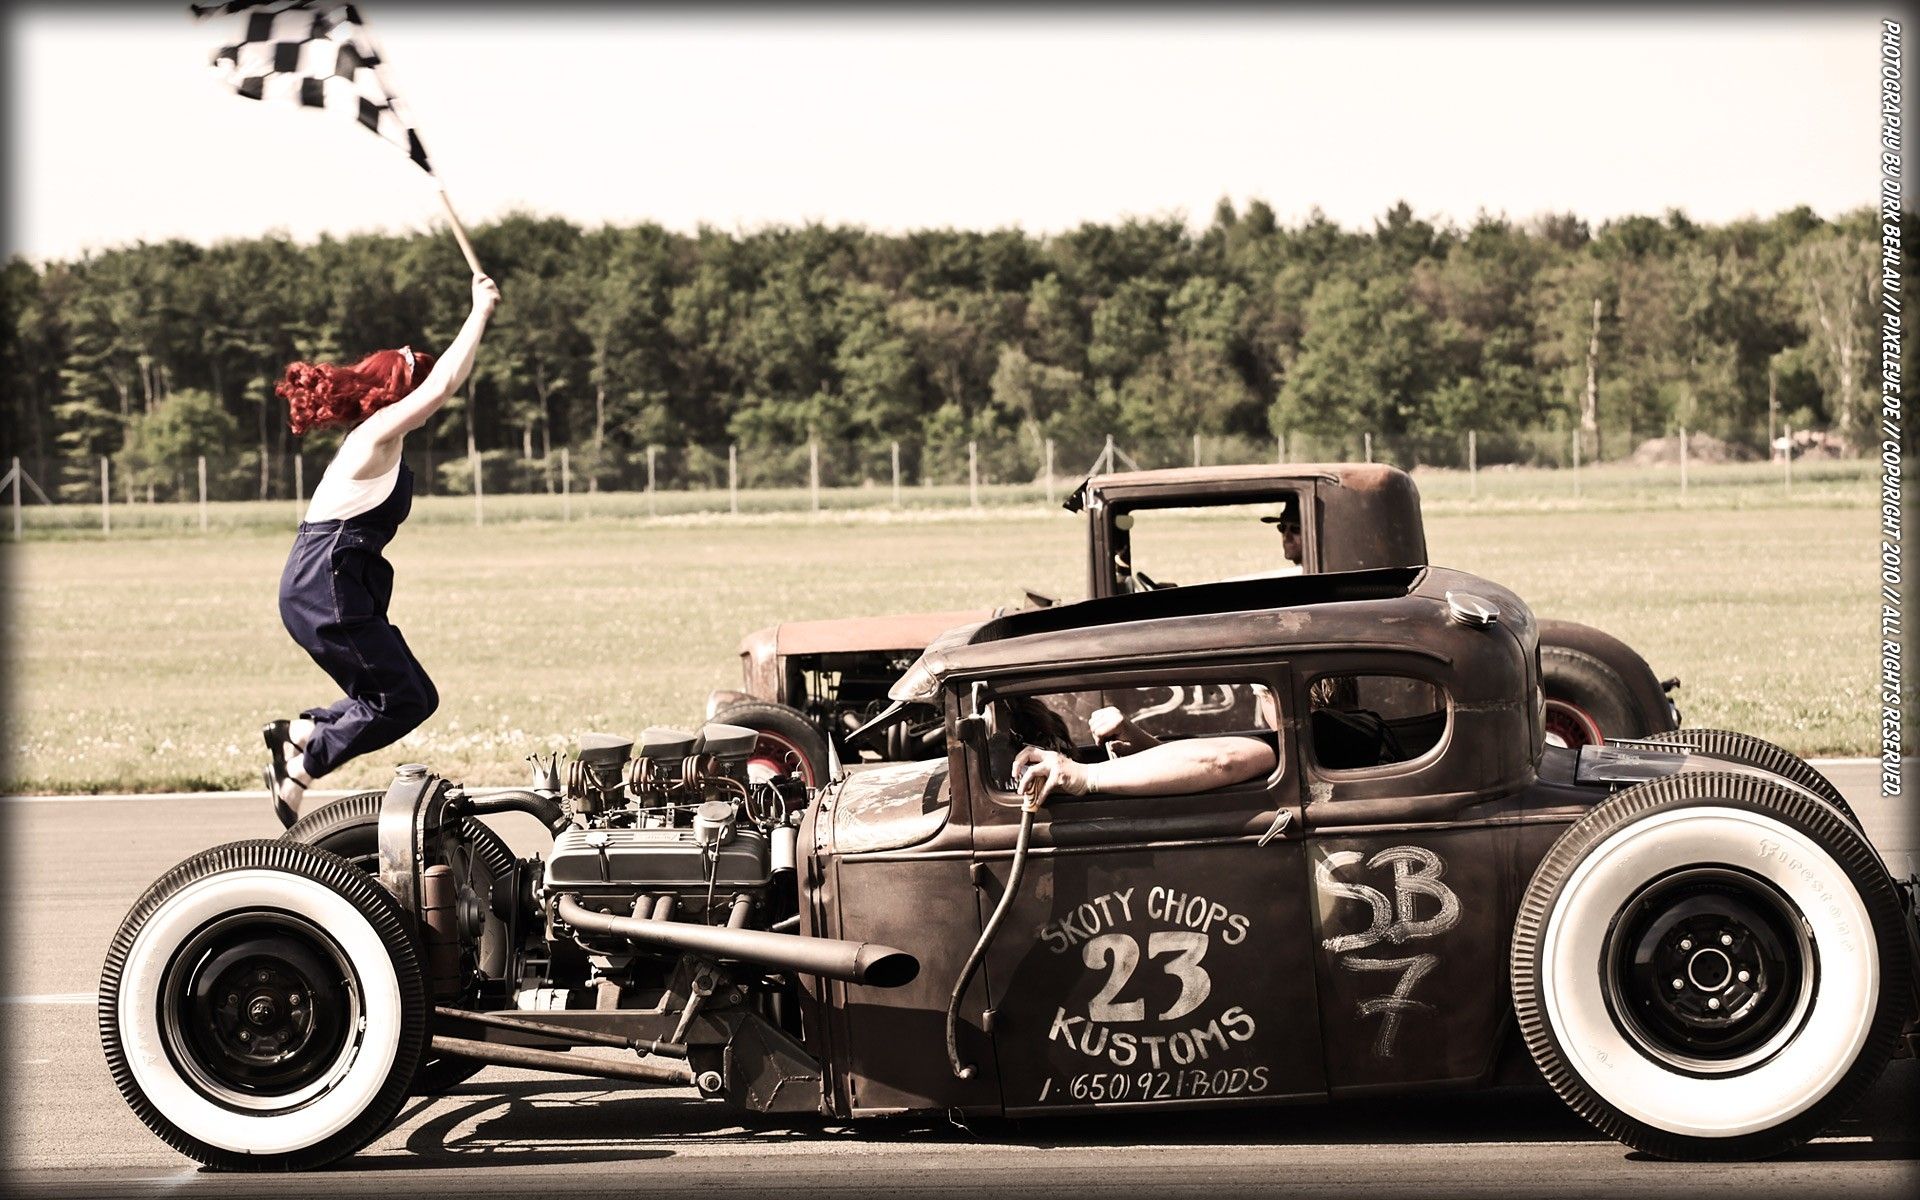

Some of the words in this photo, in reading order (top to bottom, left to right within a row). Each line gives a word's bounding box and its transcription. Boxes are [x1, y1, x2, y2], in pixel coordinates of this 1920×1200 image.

[1040, 887, 1136, 954] SKOTY
[1147, 886, 1250, 945] CHOPS
[1314, 845, 1463, 952] SB
[1082, 930, 1212, 1023] 23
[1340, 952, 1441, 1058] 7
[1048, 1006, 1256, 1070] KUSTOMS
